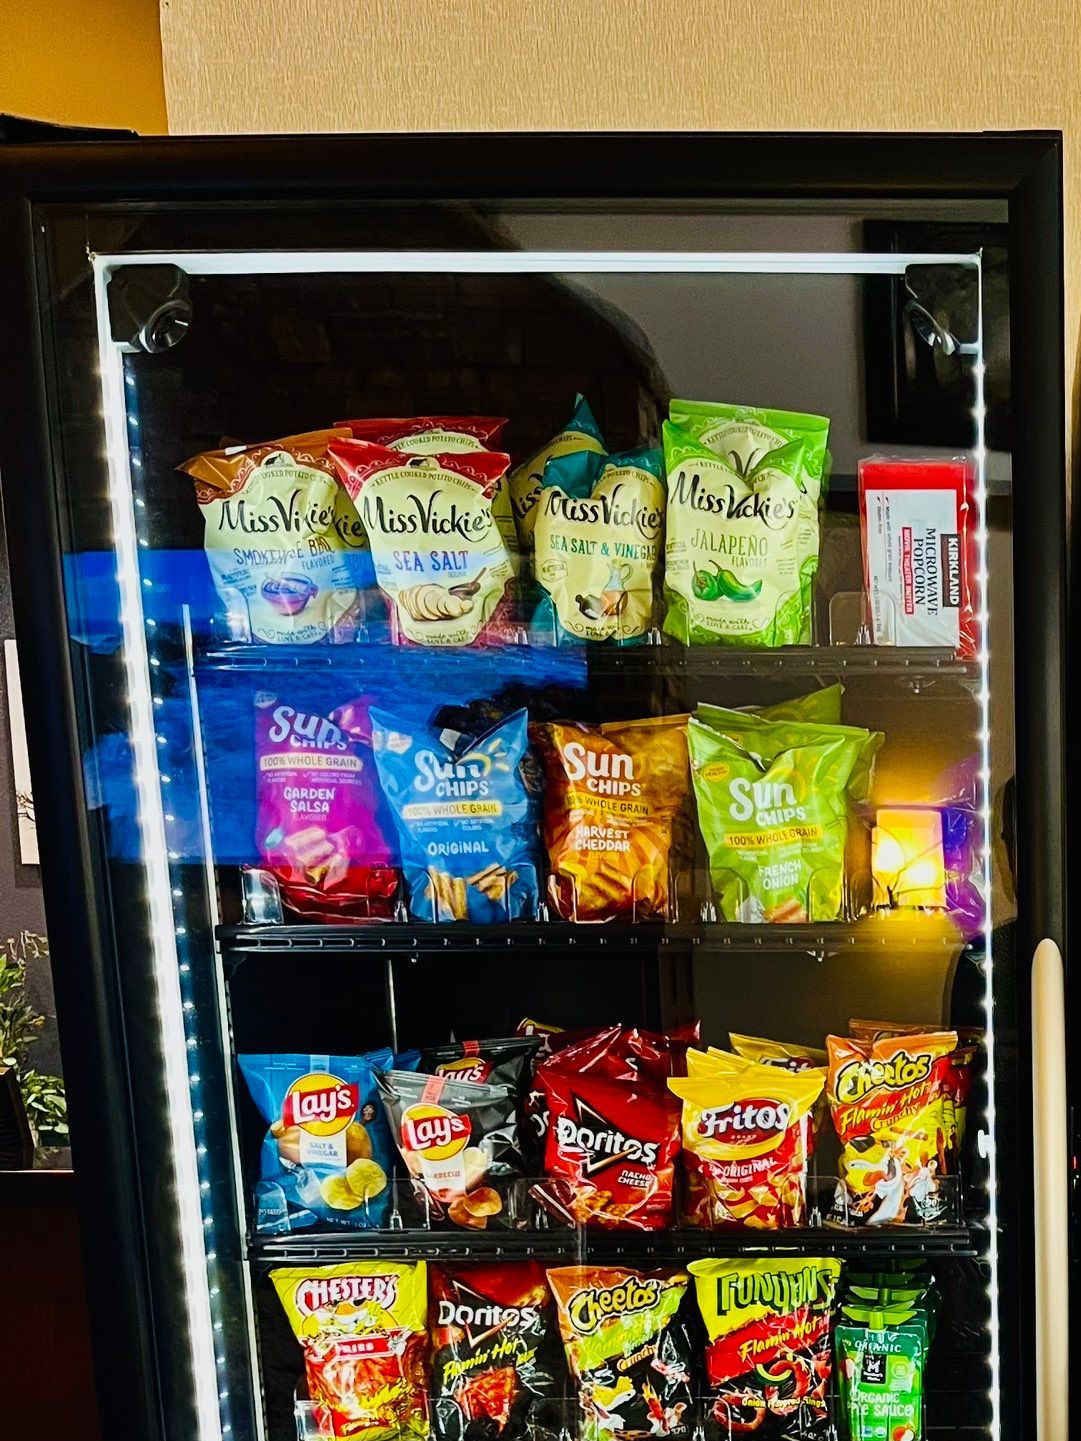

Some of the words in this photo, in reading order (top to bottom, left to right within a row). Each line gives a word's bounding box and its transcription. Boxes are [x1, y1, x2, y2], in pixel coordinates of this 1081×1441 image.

[670, 471, 725, 514] Miss
[364, 496, 417, 534] Miss
[407, 489, 493, 541] Vickie's
[545, 490, 600, 523] Miss
[550, 534, 568, 552] SEA
[571, 538, 598, 556] SALT
[394, 550, 425, 572] SEA
[431, 549, 469, 571] SALT
[914, 538, 925, 606] POPCORN
[925, 528, 938, 616] MICROWAVE
[947, 537, 961, 605] KIRKLAND
[269, 705, 342, 743] Sun
[264, 757, 285, 768] 100%
[288, 755, 323, 766] WHOLE
[325, 757, 358, 768] GRAIN
[414, 749, 482, 793] Sun
[563, 741, 635, 782] Sun
[284, 787, 336, 800] GARDEN
[435, 780, 490, 798] CHIPS
[586, 779, 642, 797] CHIPS
[729, 777, 798, 822] Sun
[289, 800, 330, 813] SALSA
[433, 804, 468, 815] WHOLE
[470, 803, 498, 814] GRAIN
[586, 798, 618, 812] WHOLE
[620, 803, 650, 816] GRAIN
[755, 807, 808, 827] CHIPS
[575, 825, 630, 840] HARVEST
[728, 835, 755, 846] 100%
[757, 832, 789, 845] WHOLE
[790, 828, 819, 839] GRAIN
[575, 838, 631, 852] CHEDDAR
[759, 860, 802, 877] FRENCH
[762, 874, 799, 891] ONION
[836, 1051, 932, 1102] Cheetos
[293, 1084, 354, 1126] Lay's
[699, 1101, 791, 1139] Fritos
[408, 1116, 469, 1151] Lay's
[557, 1115, 661, 1165] Doritos
[307, 1149, 338, 1158] VINEGAR
[621, 1169, 652, 1180] NACHO
[437, 1300, 539, 1327] Doritos
[569, 1277, 660, 1332] Cheetos
[491, 1338, 520, 1359] Hot
